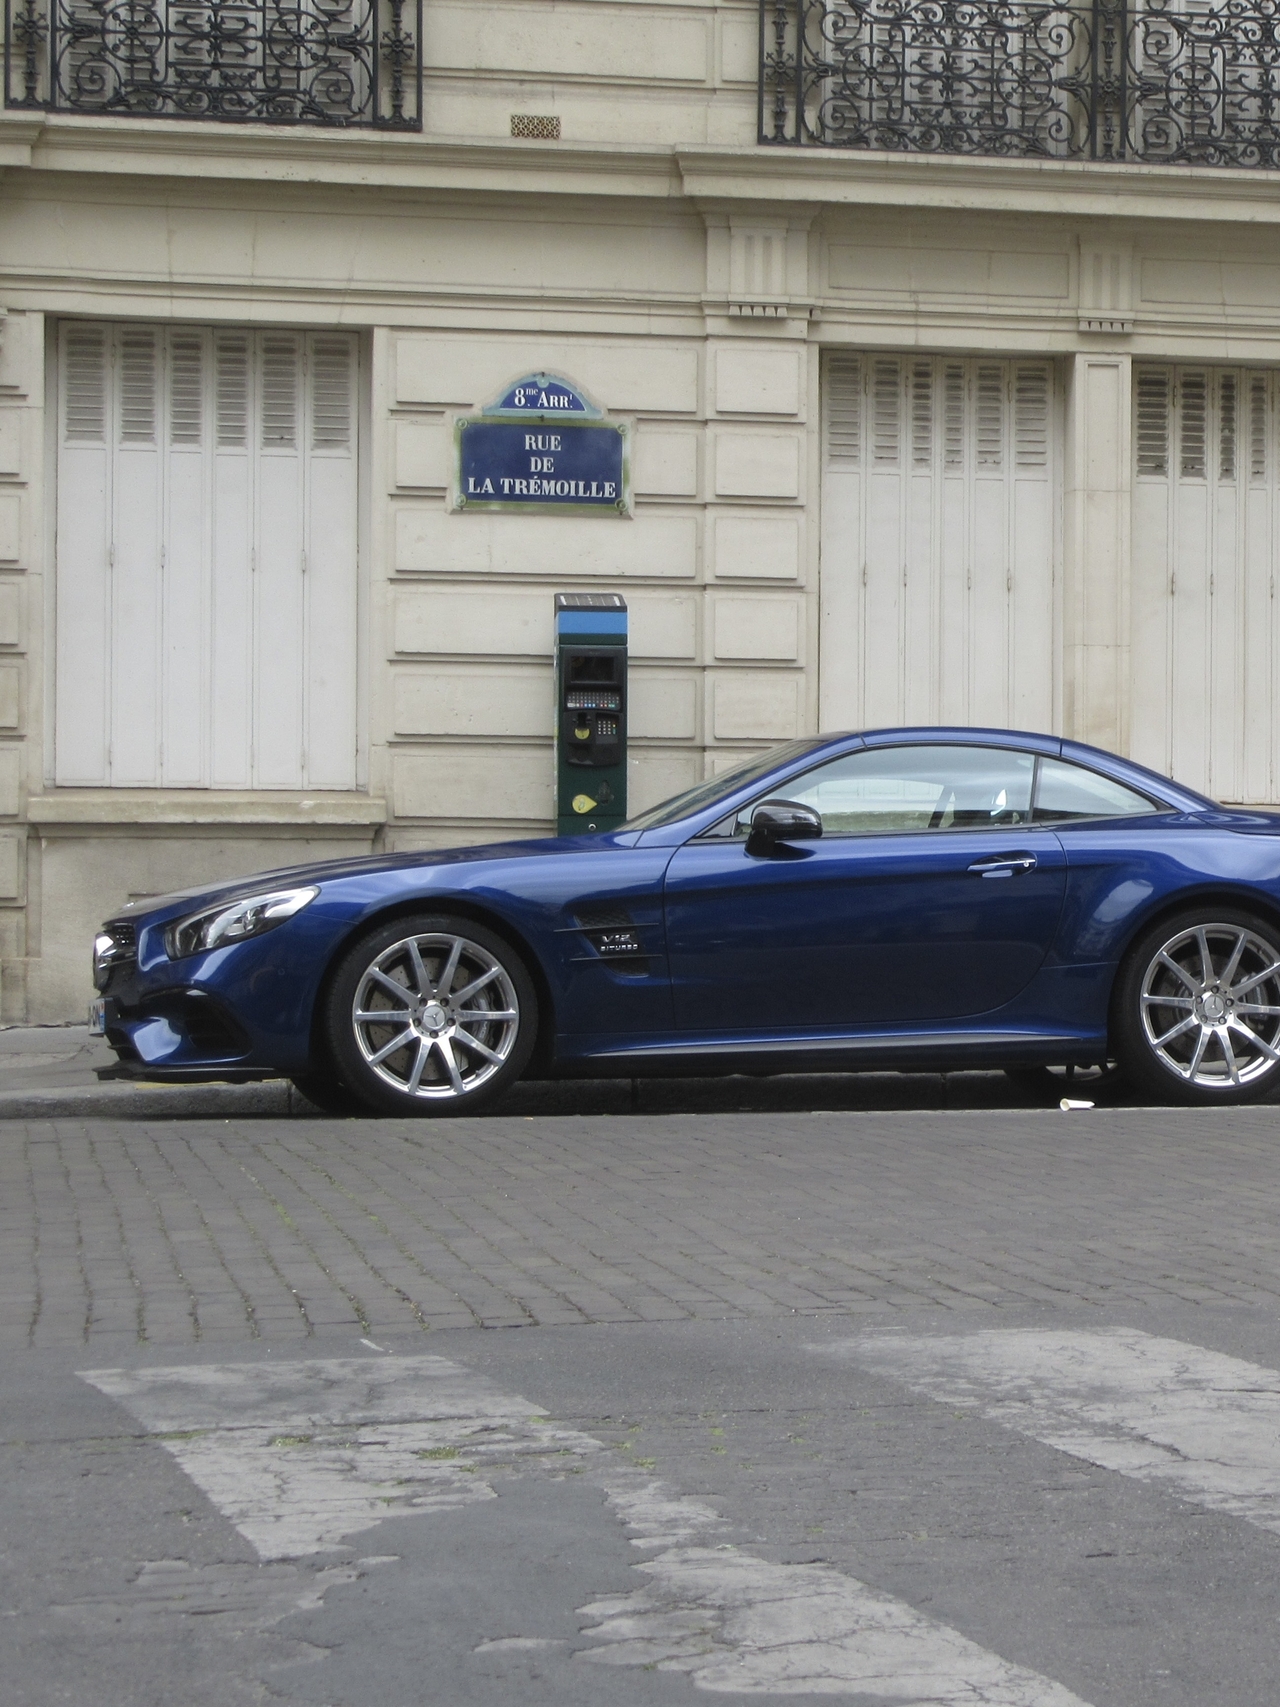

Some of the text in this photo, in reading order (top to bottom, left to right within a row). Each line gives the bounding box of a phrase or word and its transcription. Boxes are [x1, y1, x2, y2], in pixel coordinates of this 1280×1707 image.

[525, 435, 562, 451] RUE
[530, 457, 554, 473] DE
[468, 476, 616, 498] LA TRÉMOILLE
